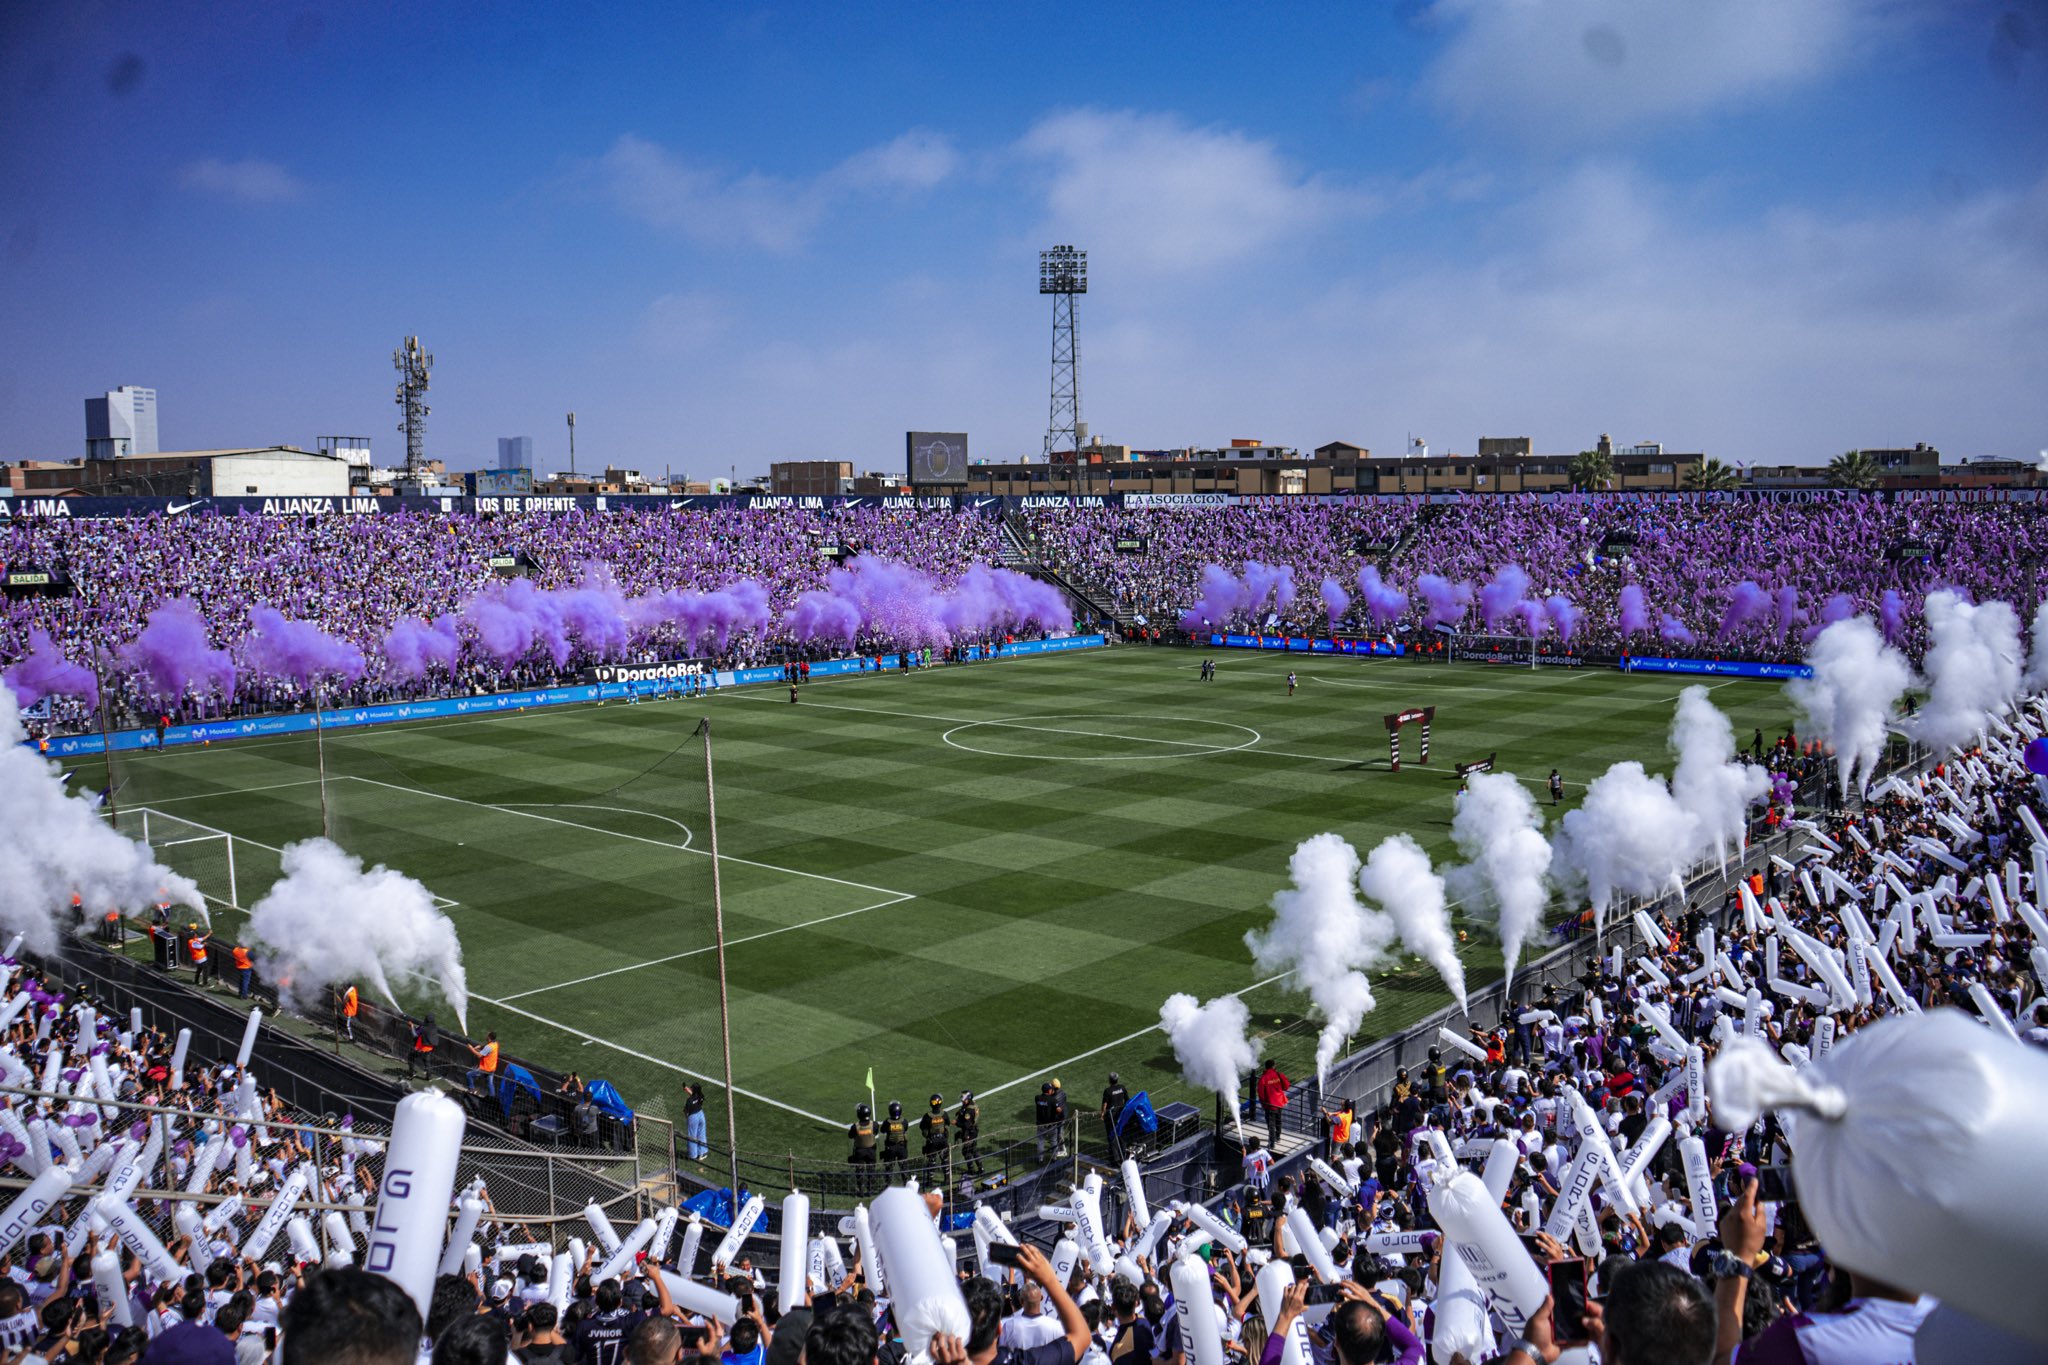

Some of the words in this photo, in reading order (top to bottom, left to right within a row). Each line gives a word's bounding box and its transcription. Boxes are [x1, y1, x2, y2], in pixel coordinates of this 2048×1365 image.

[262, 498, 336, 515] ALIANZA
[342, 498, 381, 514] LIMA
[475, 497, 500, 512] LOS
[503, 497, 521, 512] DE
[525, 497, 577, 512] ORIENTE
[749, 496, 794, 509] ALIANZA
[798, 496, 824, 509] LIMA
[1020, 496, 1070, 508] ALIANZA
[1076, 496, 1105, 508] LIMA
[1127, 495, 1143, 504] LA
[21, 499, 71, 517] LIMA
[491, 558, 515, 568] SALIDA
[13, 573, 46, 584] SALIDA
[1462, 651, 1513, 661] DoradoBet
[1528, 654, 1582, 666] DoradoBet
[617, 662, 703, 683] DoradoBet
[209, 727, 237, 736] Movistar
[1689, 1055, 1698, 1096] GLORY
[1566, 1151, 1599, 1211] GLORY
[269, 1184, 301, 1229] GLORY
[736, 1205, 760, 1239] GLORY
[1074, 1200, 1095, 1243] GLORY
[110, 1215, 151, 1262] GLORY
